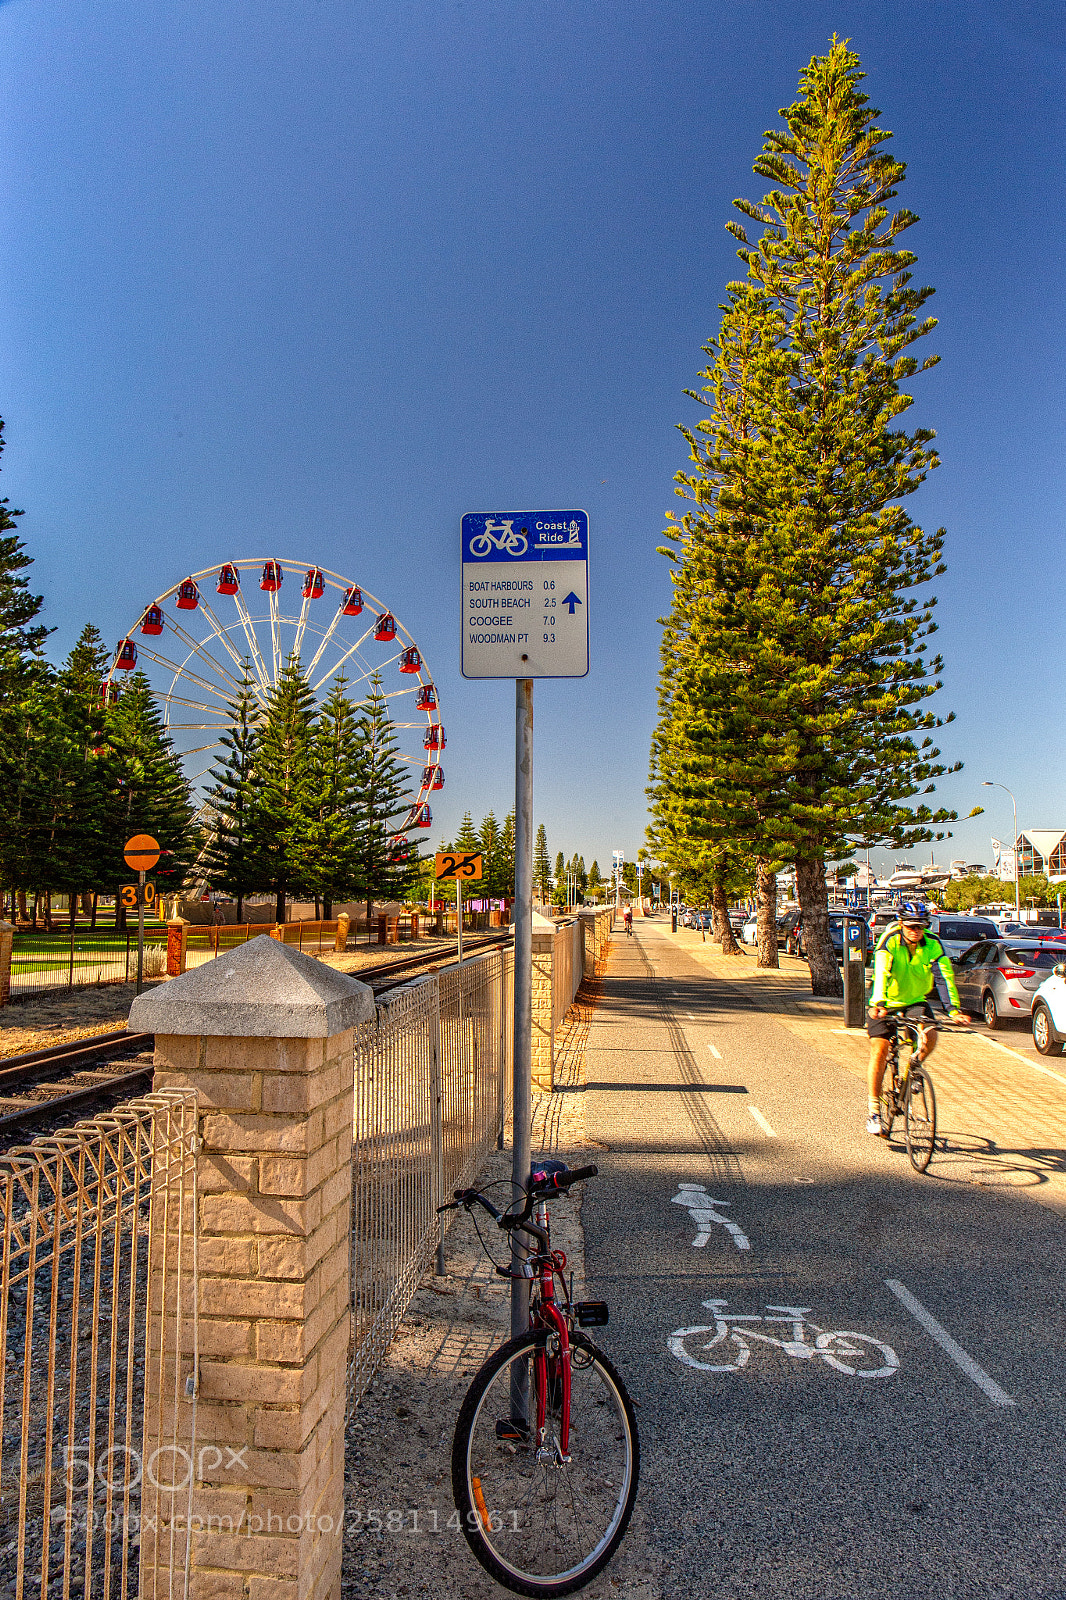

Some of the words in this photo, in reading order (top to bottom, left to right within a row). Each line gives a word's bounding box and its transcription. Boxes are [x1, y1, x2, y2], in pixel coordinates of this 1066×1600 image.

[535, 521, 567, 530] Coast
[539, 533, 563, 542] Ride
[469, 581, 489, 592] BOAT
[491, 580, 533, 591] HARBOURS
[543, 580, 555, 590] 0.6
[469, 598, 501, 609] SOUTH
[501, 598, 531, 608] BEACH
[544, 598, 557, 608] 2.5
[469, 616, 513, 626] COOGEE
[543, 616, 556, 626] 7.0
[469, 633, 516, 644] WOODMAN
[518, 633, 529, 643] PT
[543, 633, 556, 643] 9.3
[442, 856, 476, 877] 25
[850, 929, 860, 940] P
